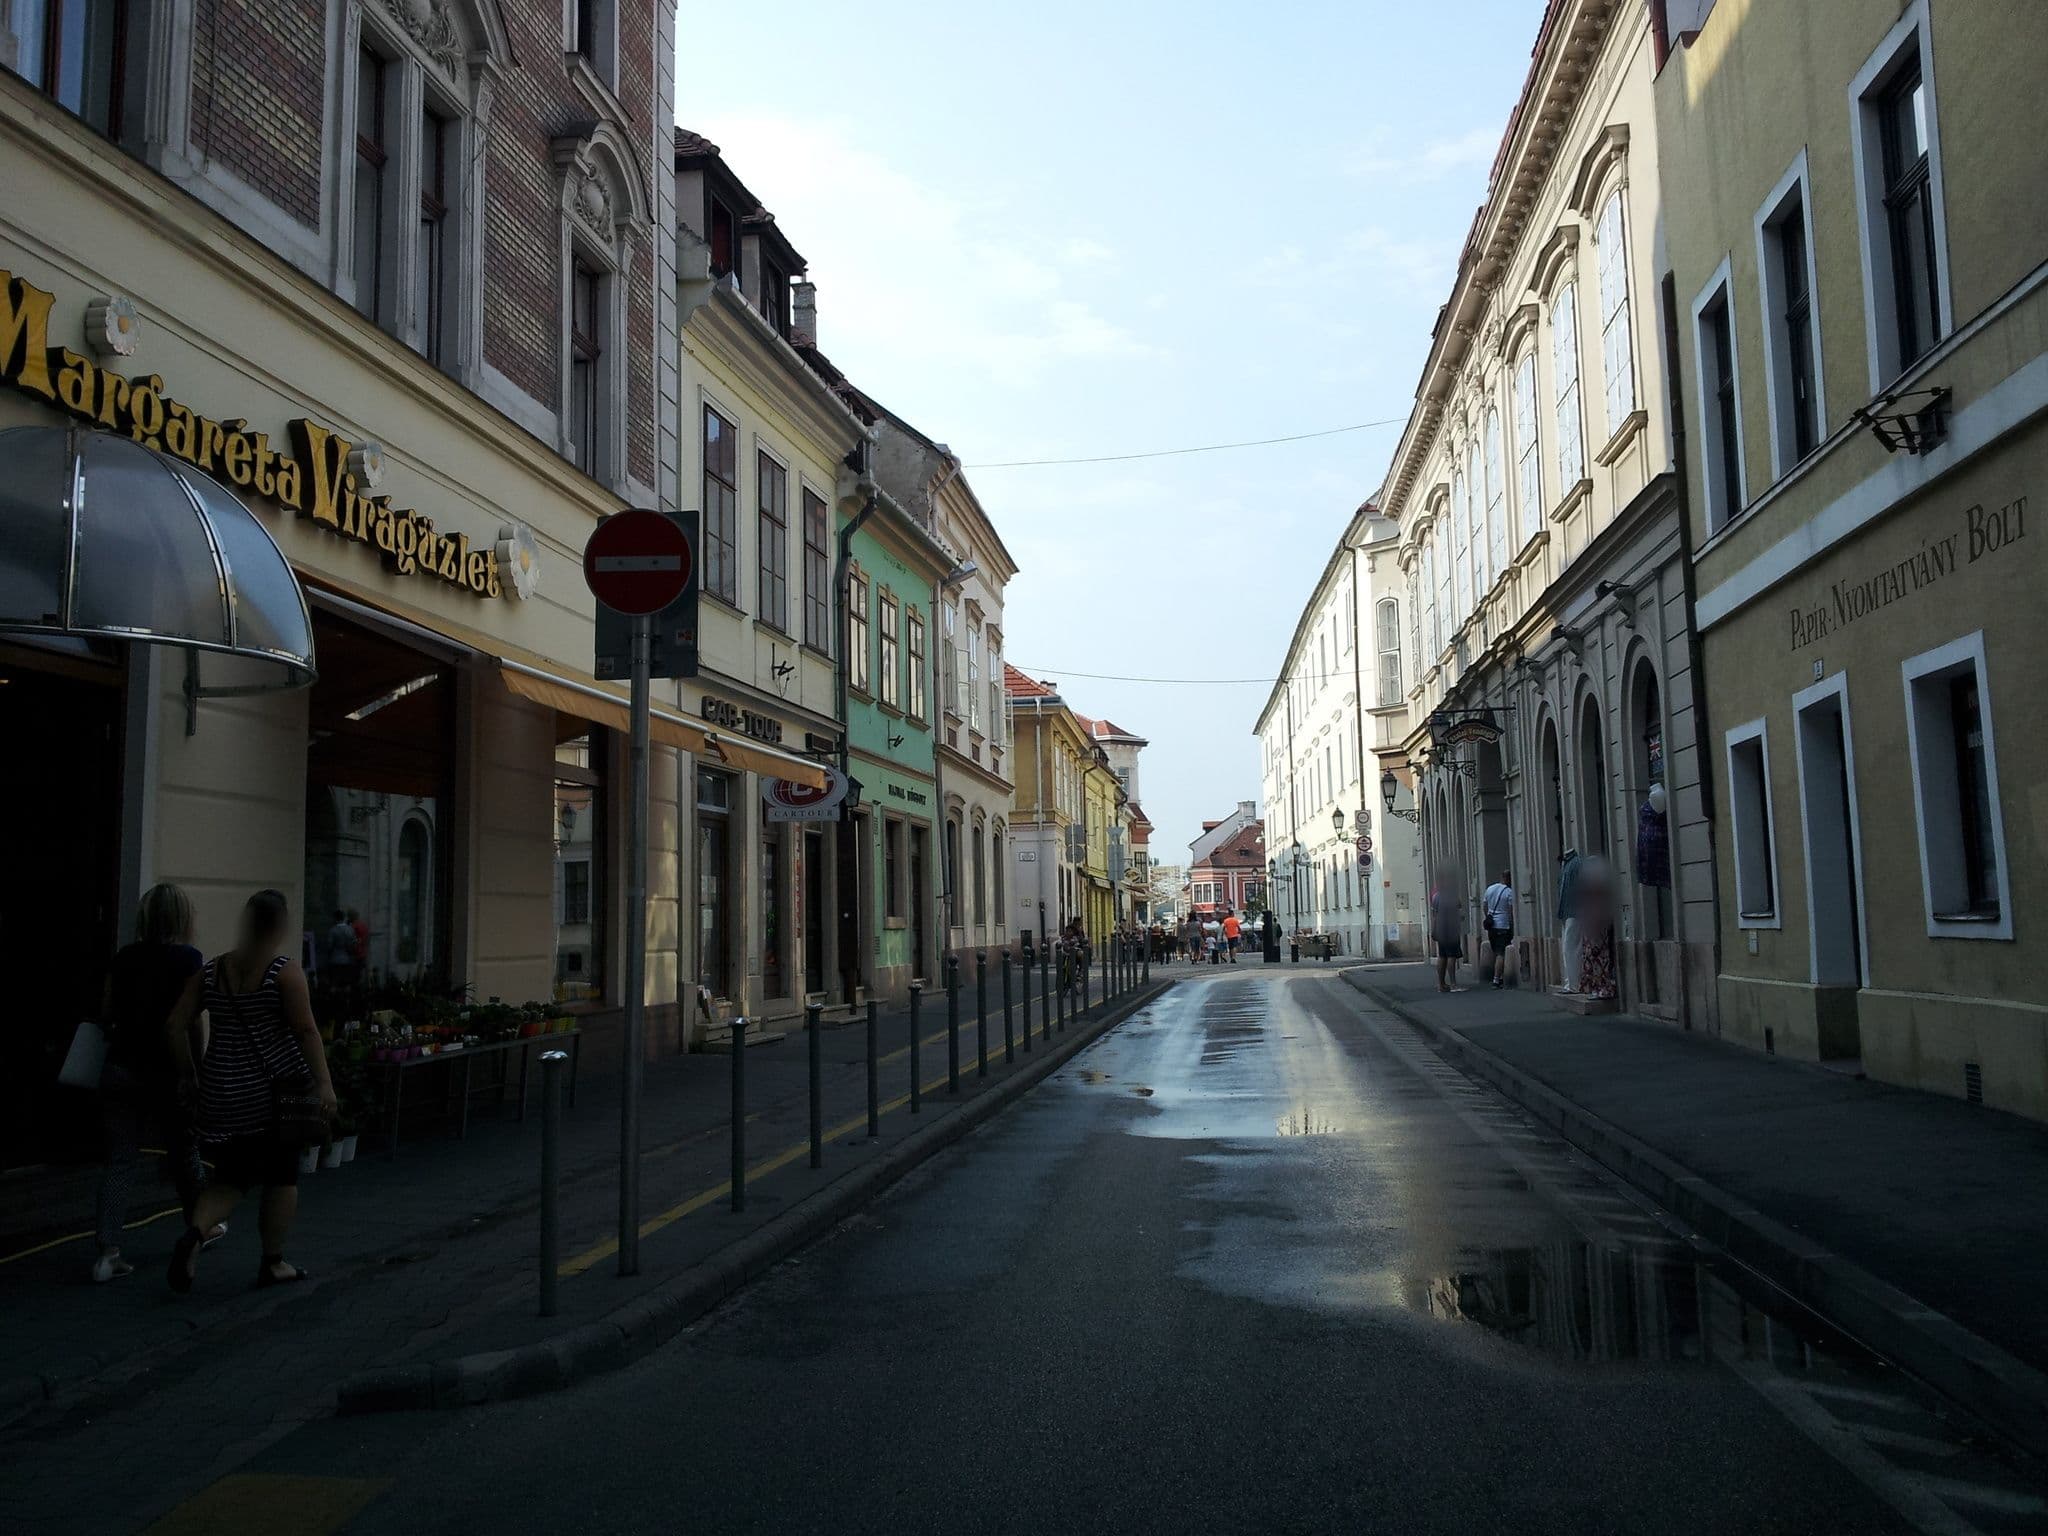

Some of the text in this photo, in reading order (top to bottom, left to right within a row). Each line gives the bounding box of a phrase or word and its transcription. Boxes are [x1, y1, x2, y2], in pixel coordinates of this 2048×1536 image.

[298, 418, 500, 598] Virágüzlet
[1965, 495, 2028, 563] BOLT
[702, 695, 783, 742] CAR-TOUR
